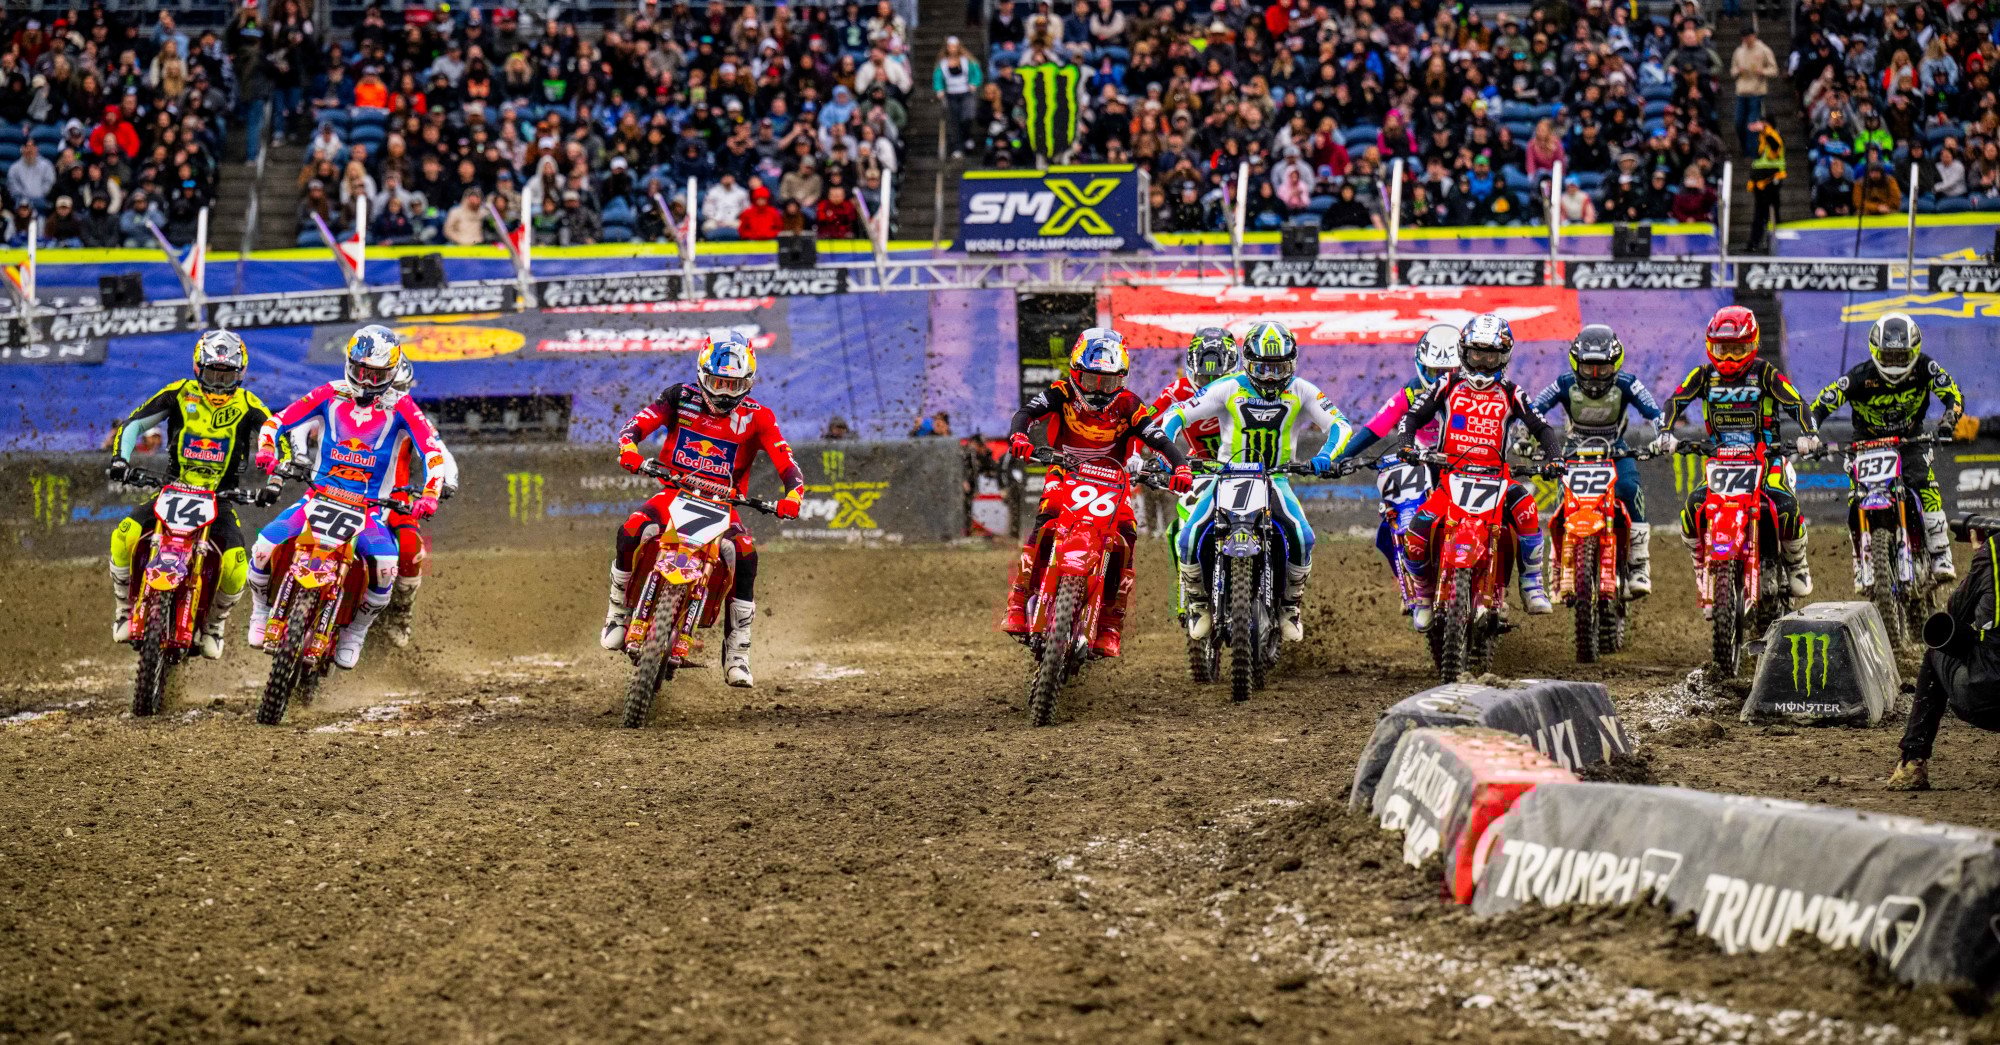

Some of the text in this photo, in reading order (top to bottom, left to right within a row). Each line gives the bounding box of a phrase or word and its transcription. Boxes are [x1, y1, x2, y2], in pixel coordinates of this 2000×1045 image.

[964, 178, 1121, 236] SMX
[965, 237, 1125, 251] WORLD CHAMPIONSHIP
[1811, 263, 1879, 276] MOUNTAIN
[1255, 398, 1282, 406] YAMAHA
[1708, 386, 1762, 402] FXR
[1453, 396, 1504, 417] FXR
[1467, 424, 1499, 437] LOCK
[1468, 415, 1500, 428] QUAD
[1450, 432, 1497, 445] HONDA
[183, 448, 226, 463] Red Bull
[331, 449, 376, 467] Red Bull
[675, 449, 731, 476] Red Bull
[1081, 468, 1117, 480] RENTHAL
[1857, 456, 1898, 478] 637
[1382, 466, 1428, 501] 44
[1570, 470, 1611, 494] 62
[1710, 467, 1757, 494] 874
[1071, 485, 1119, 517] 96
[1231, 479, 1255, 511] 1
[1458, 481, 1500, 508] 17
[165, 496, 207, 528] 14
[308, 504, 364, 542] 26
[676, 502, 727, 537] 7
[1774, 701, 1841, 714] MONSTER
[1495, 838, 1641, 907] TRIUMPH
